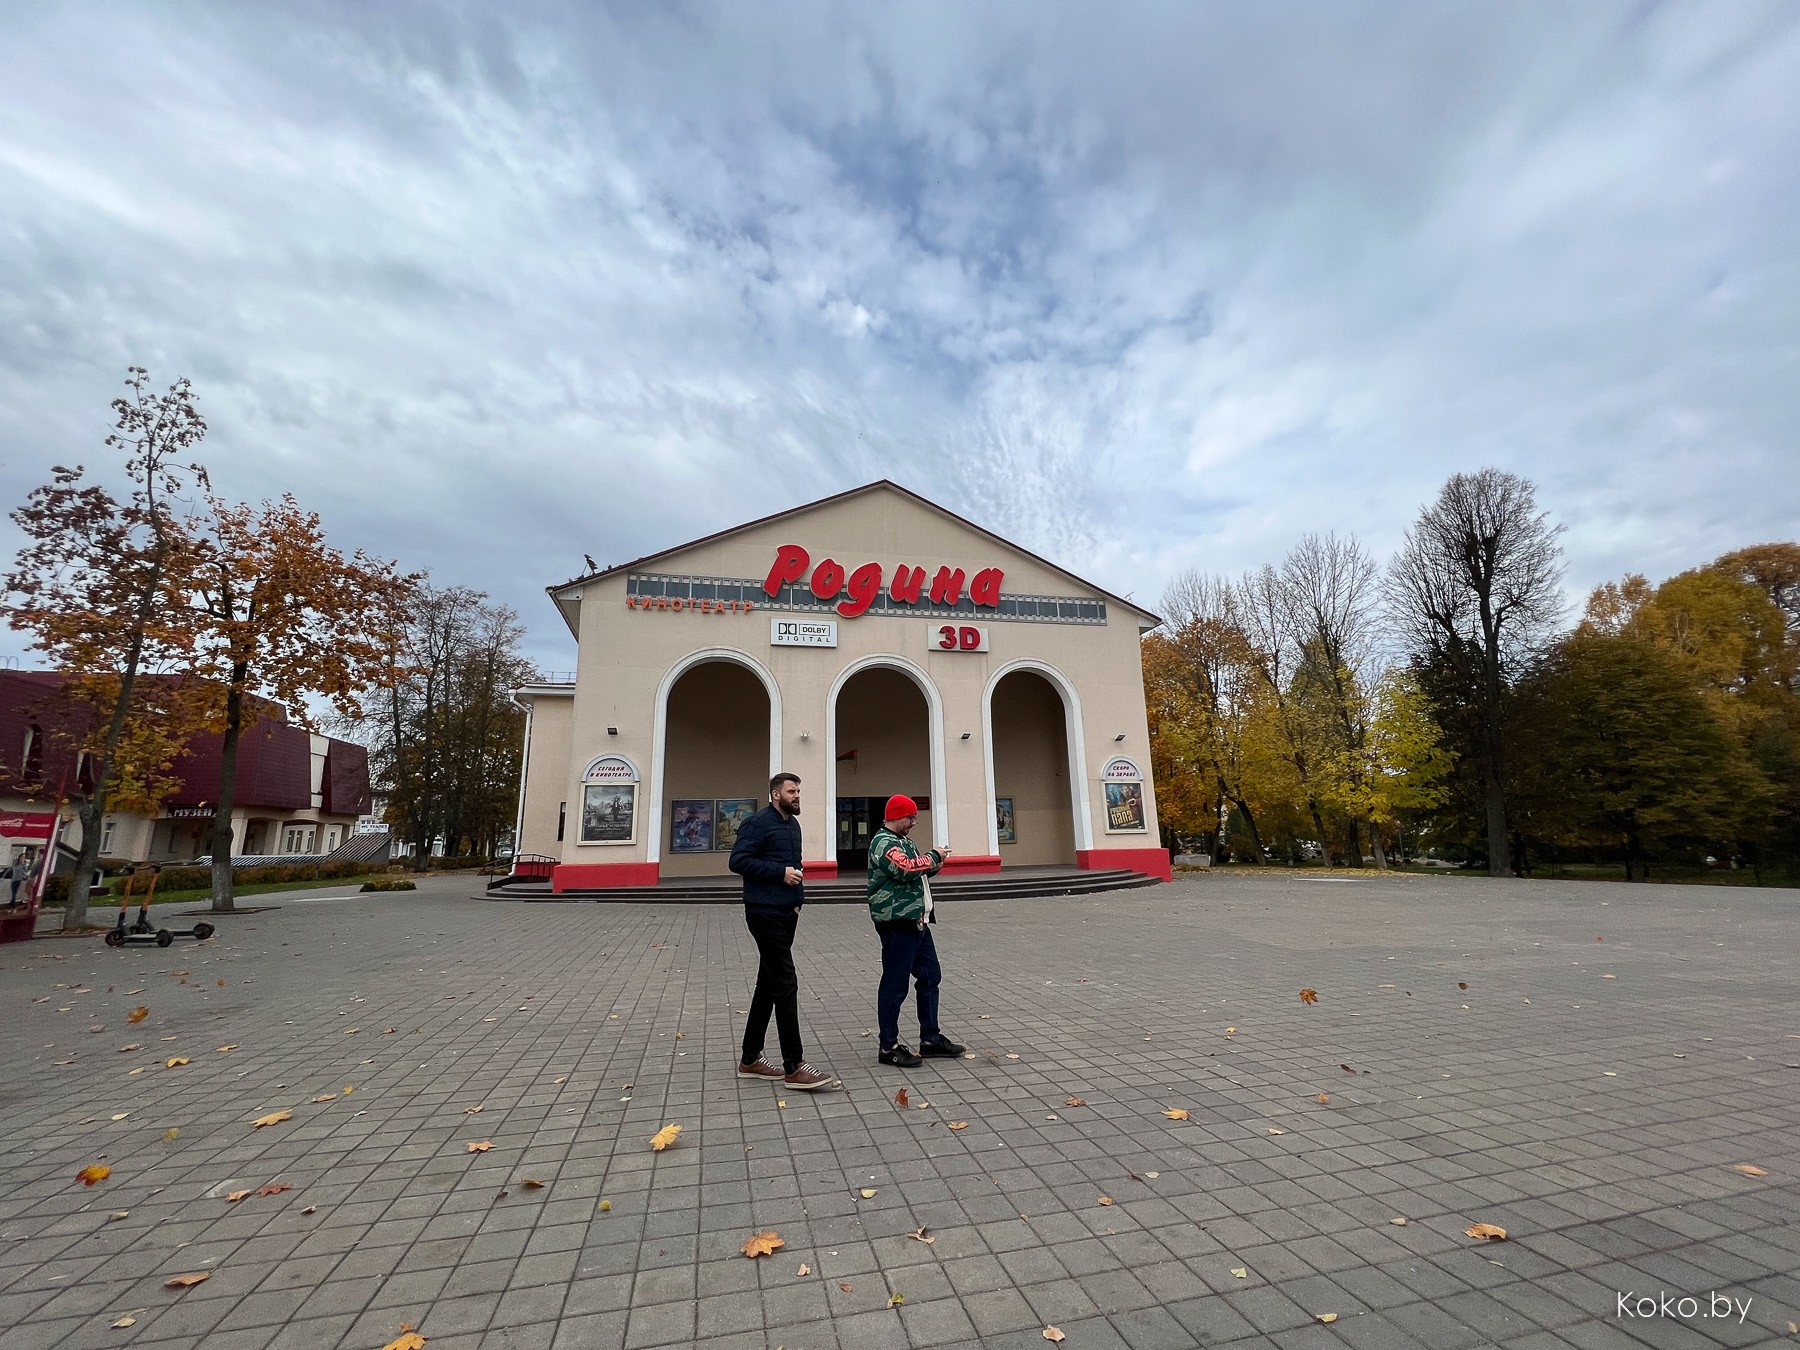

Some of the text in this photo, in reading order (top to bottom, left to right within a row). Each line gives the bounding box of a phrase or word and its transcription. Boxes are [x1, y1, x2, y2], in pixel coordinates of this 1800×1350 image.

[763, 544, 1005, 618] Родина
[627, 596, 753, 614] КИНОТЕАТР
[802, 626, 827, 634] DOLBY
[778, 635, 831, 643] DIGITAL
[939, 625, 981, 650] 3D
[173, 807, 213, 817] МУЗЕЙ
